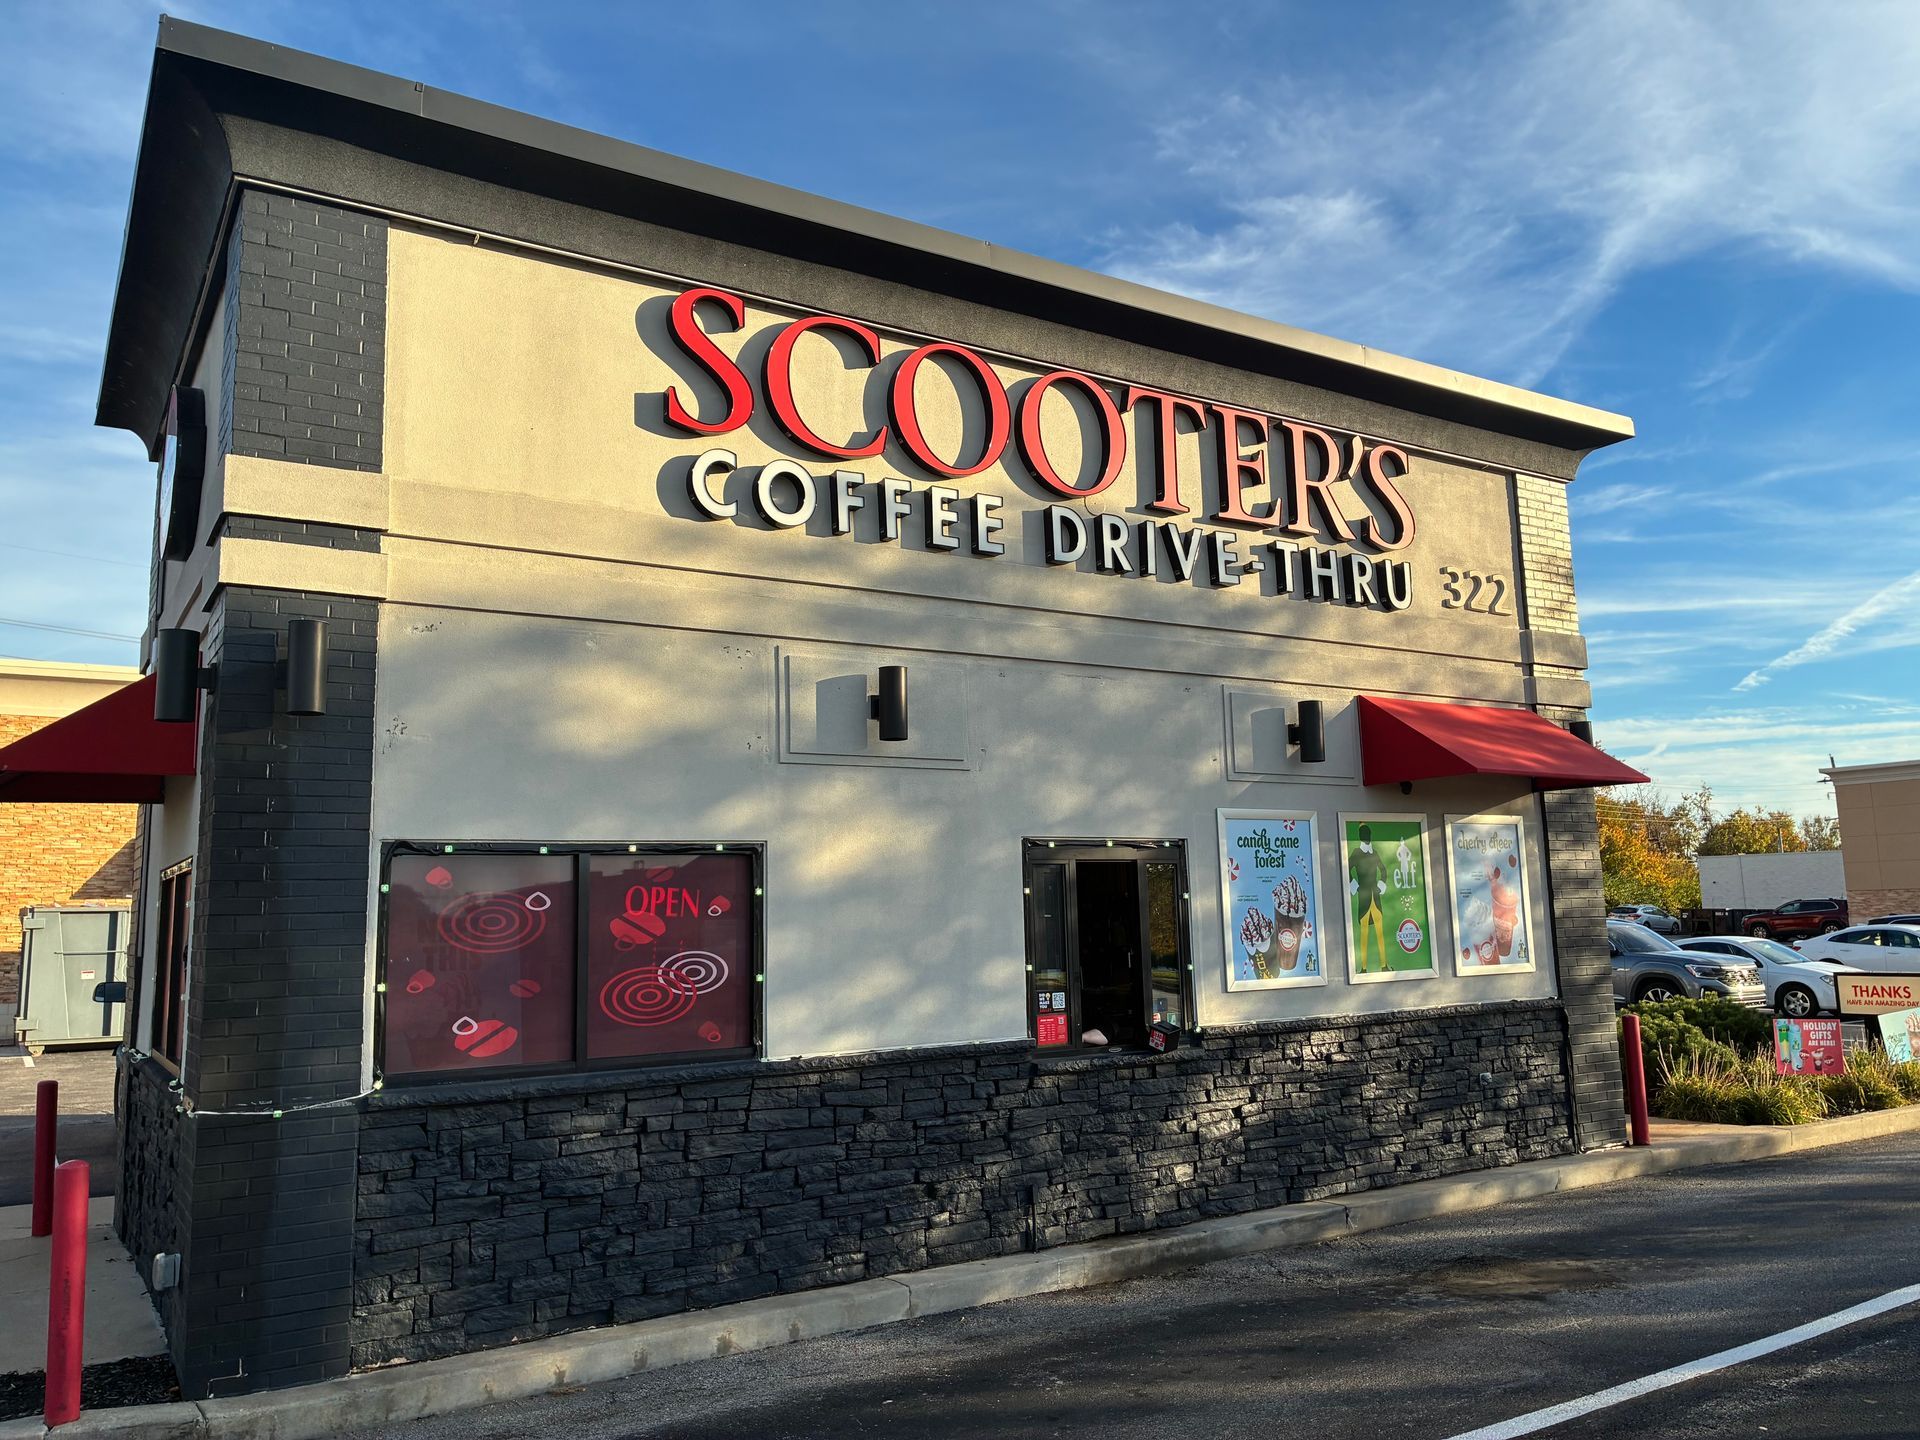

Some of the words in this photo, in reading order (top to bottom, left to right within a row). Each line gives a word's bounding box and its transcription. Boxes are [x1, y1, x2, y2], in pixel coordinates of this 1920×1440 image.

[665, 288, 1415, 552] SCOOTER'S
[688, 448, 1005, 557] COFFEE
[1046, 505, 1413, 612] DRIVE-THRU
[1440, 566, 1512, 615] 322
[1237, 828, 1278, 854] candy
[1274, 836, 1300, 849] cane
[1458, 830, 1486, 853] cherry
[1488, 832, 1513, 853] cheer
[1254, 850, 1286, 869] forest
[1393, 846, 1417, 889] elf
[625, 884, 701, 919] OPEN
[1852, 984, 1912, 999] THANKS
[1802, 1021, 1837, 1031] HOLIDAY
[1809, 1031, 1832, 1040] GIFTS
